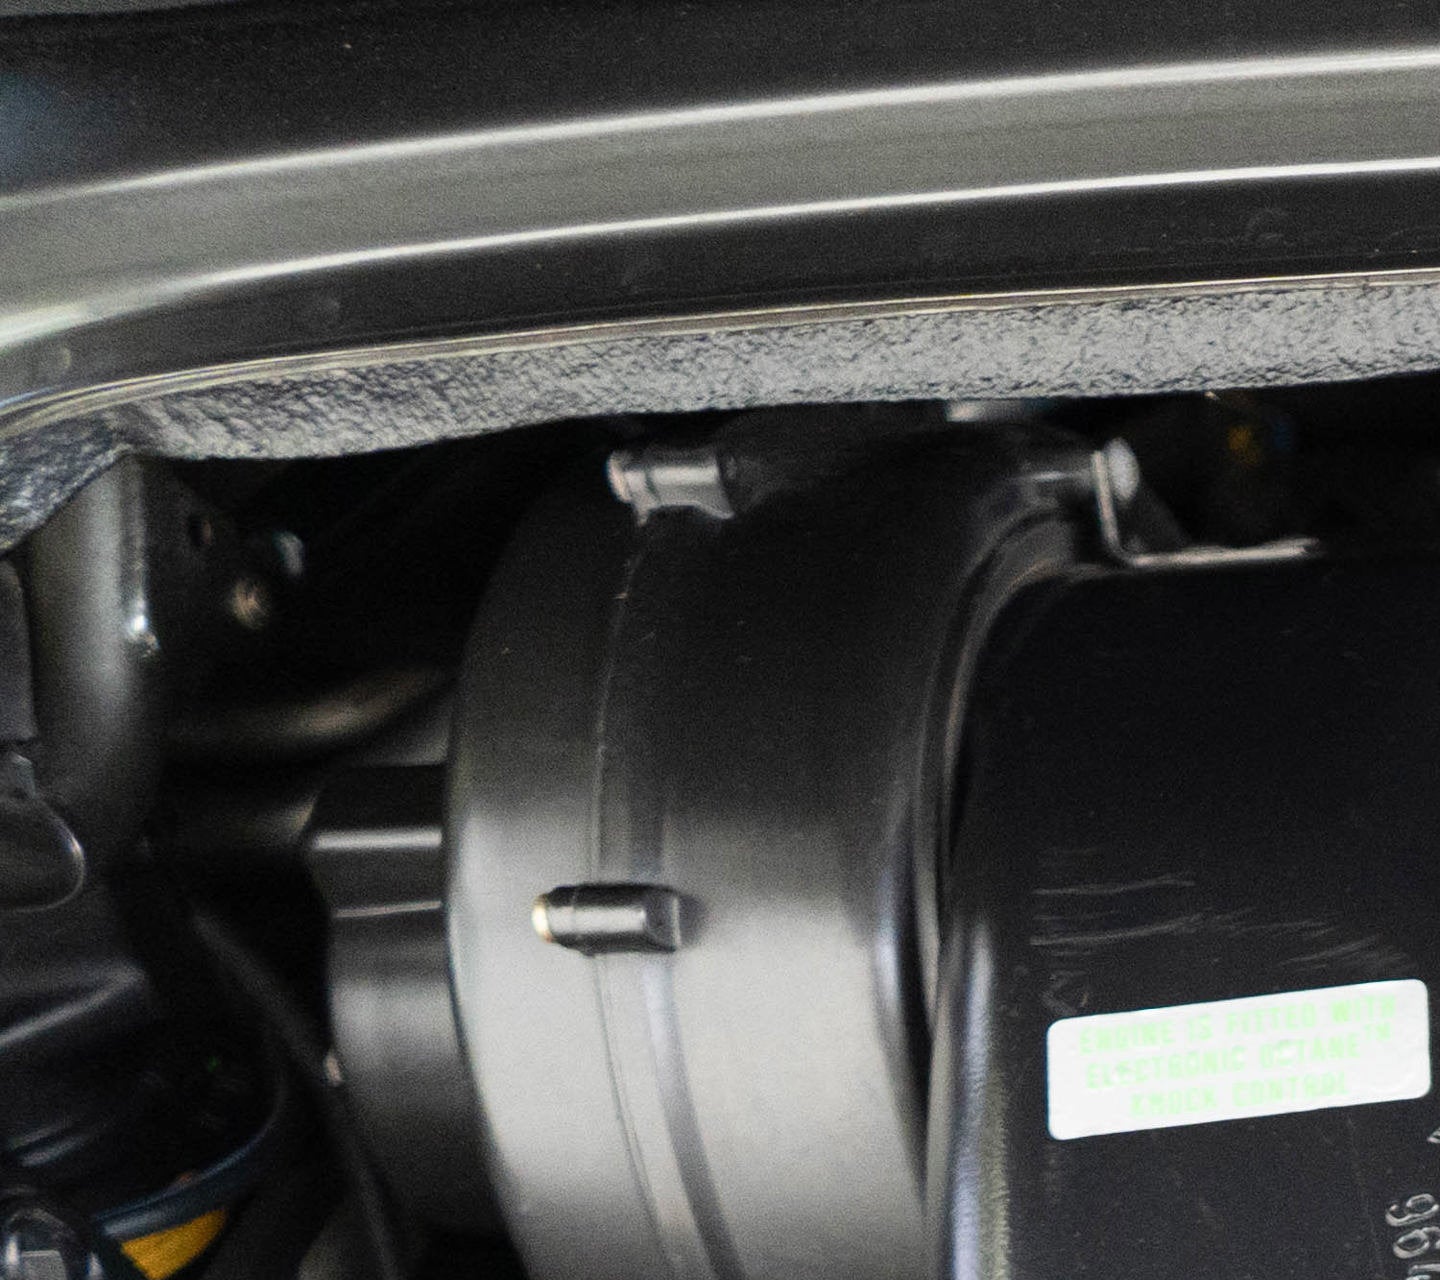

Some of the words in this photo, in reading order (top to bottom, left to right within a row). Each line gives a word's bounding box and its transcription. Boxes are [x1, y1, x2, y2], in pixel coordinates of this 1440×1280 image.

[1080, 1021, 1175, 1053] ENGINE
[1187, 1014, 1213, 1043] IS
[1227, 1005, 1316, 1037] FITTED
[1332, 995, 1396, 1024] WITH
[1085, 1045, 1246, 1090] ELECTRONIC
[1130, 1090, 1219, 1117] KNOCK
[1232, 1072, 1349, 1107] CONTROL
